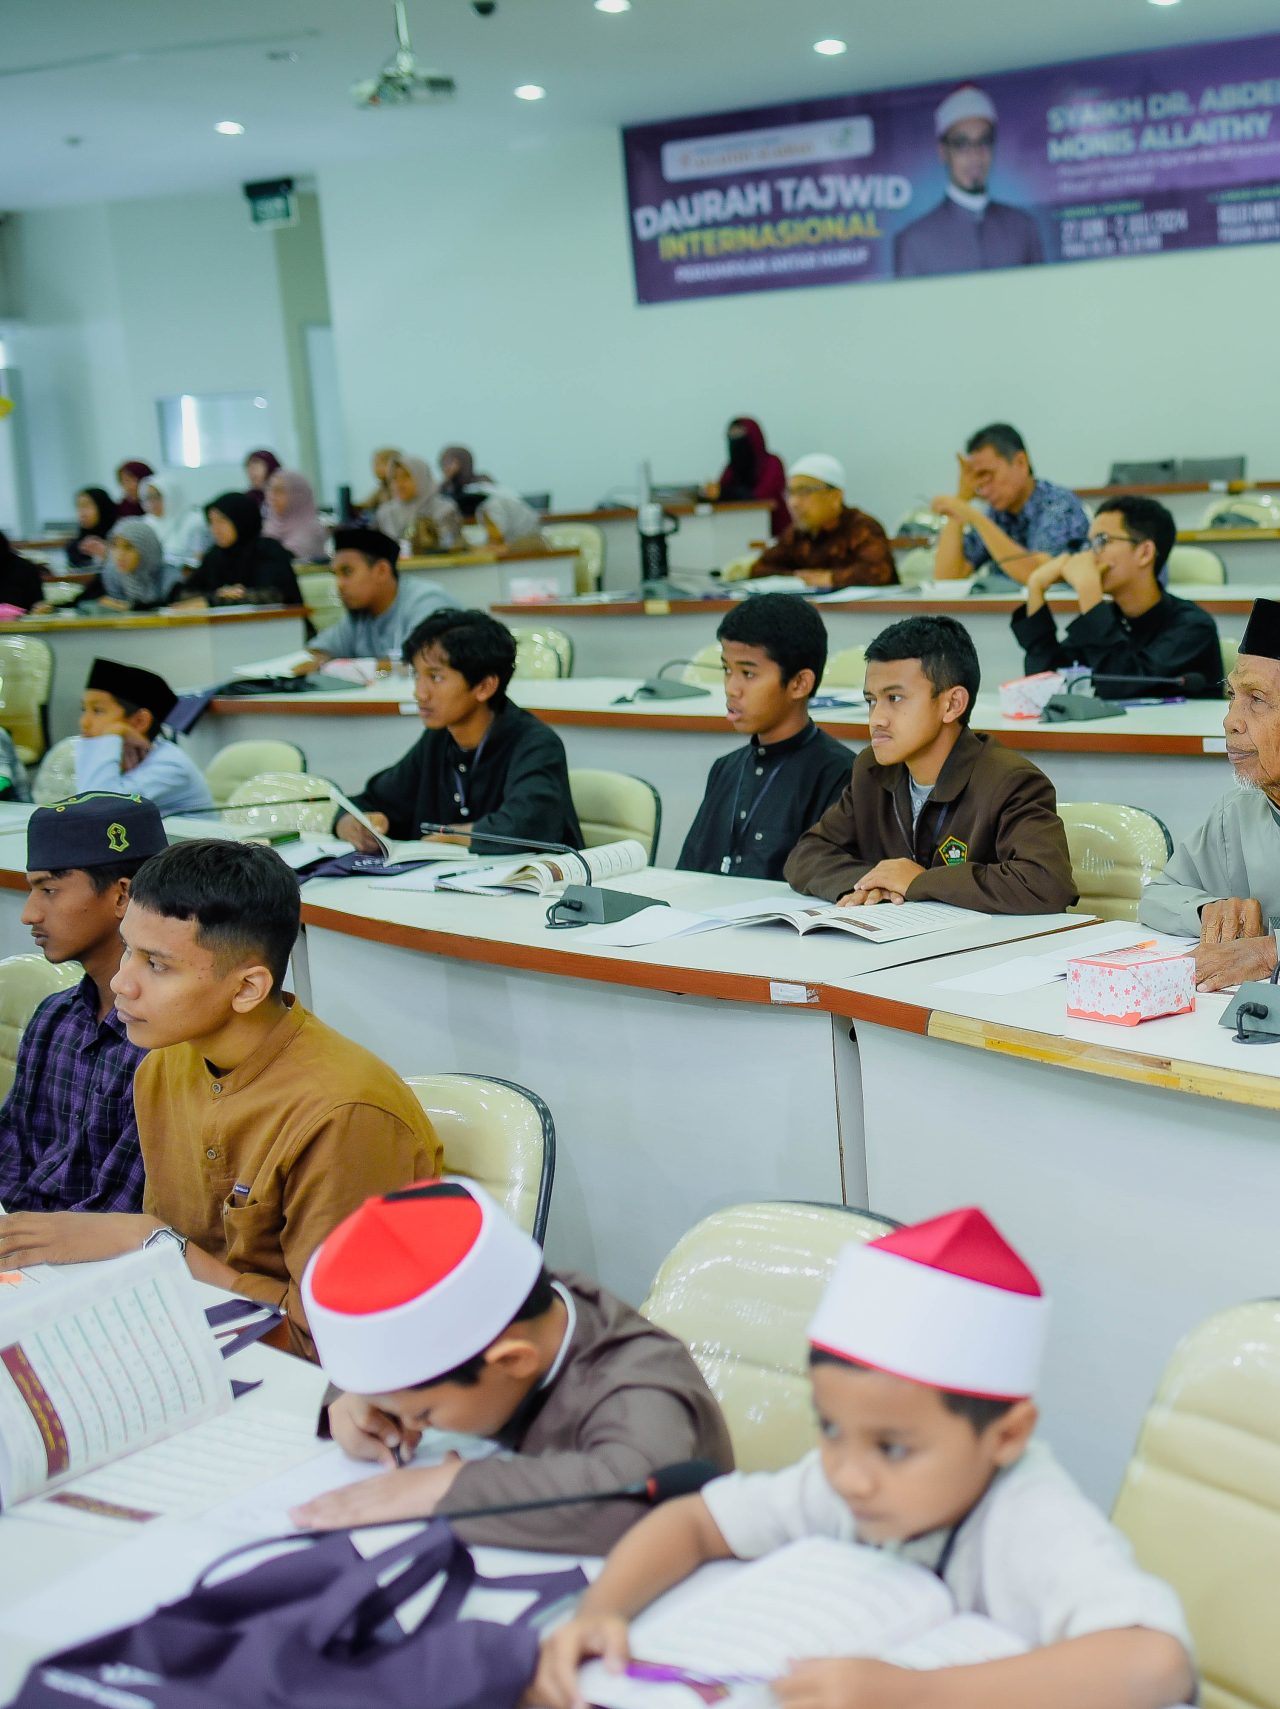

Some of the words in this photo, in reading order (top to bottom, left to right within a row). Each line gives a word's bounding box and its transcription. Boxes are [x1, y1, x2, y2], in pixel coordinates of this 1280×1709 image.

[1139, 111, 1272, 150] ALLAITHY
[634, 182, 772, 240] DAURAH
[775, 174, 912, 212] TAJWID
[659, 212, 880, 261] INTERNASIONAL
